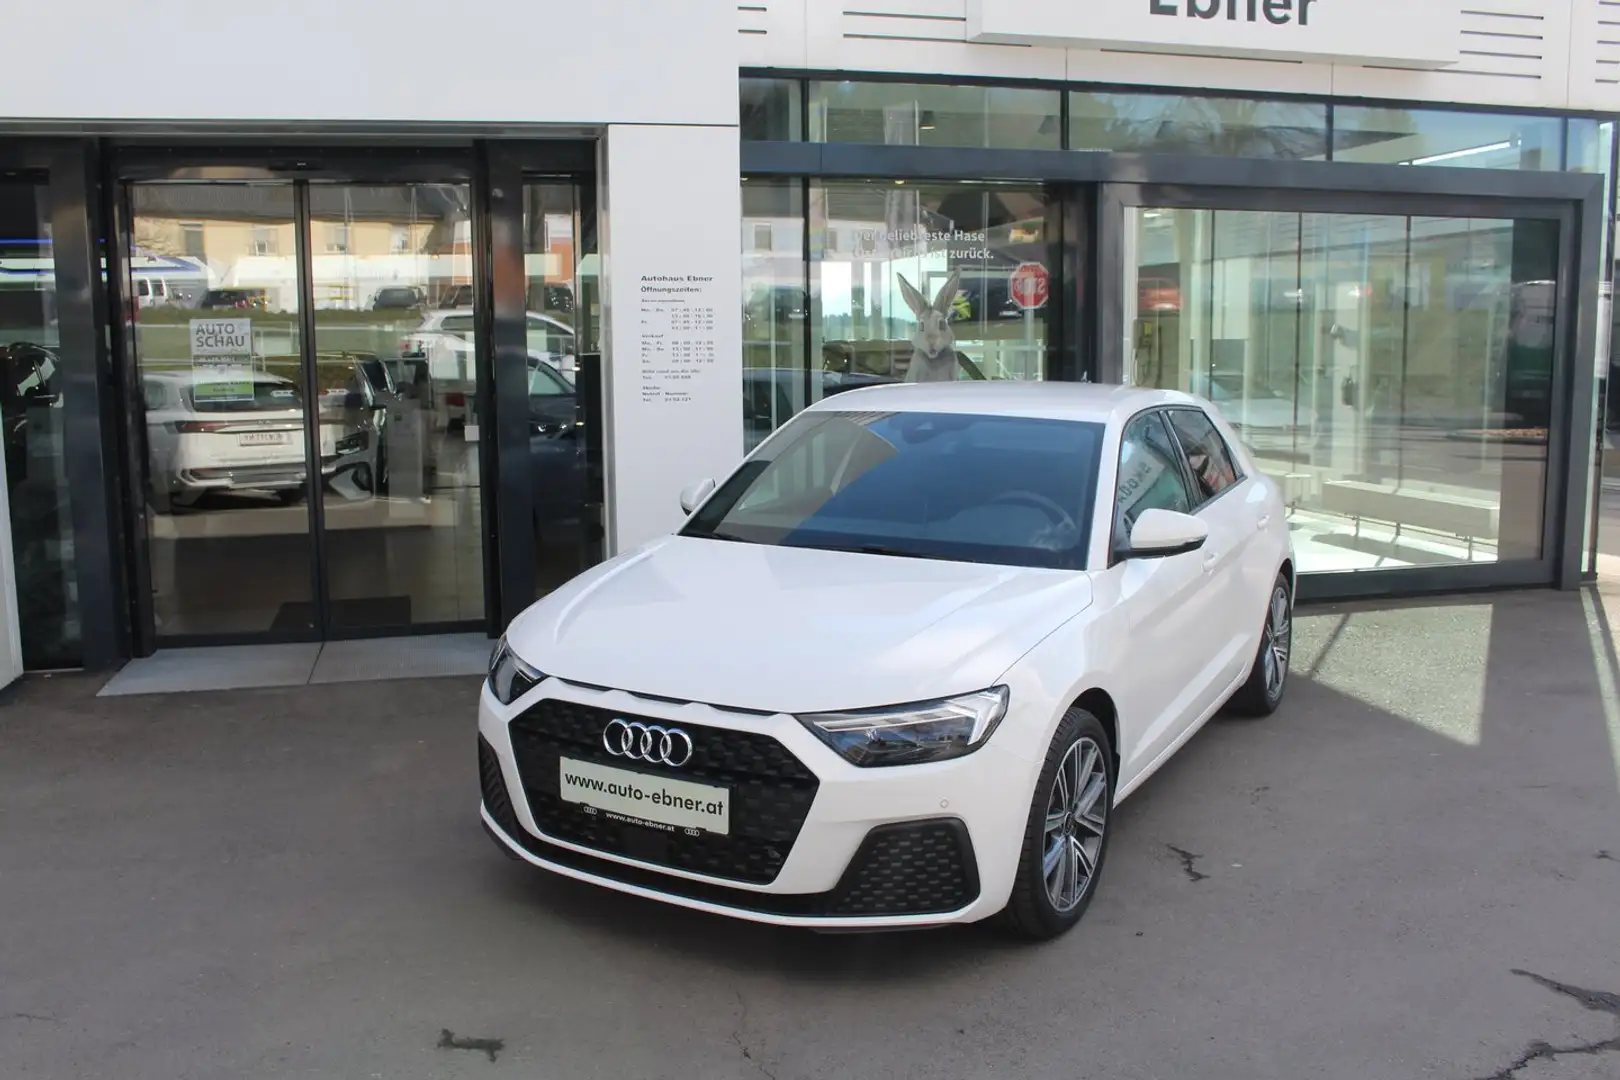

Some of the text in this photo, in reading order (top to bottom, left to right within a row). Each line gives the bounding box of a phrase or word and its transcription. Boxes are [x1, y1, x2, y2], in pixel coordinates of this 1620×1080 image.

[954, 229, 985, 242] Hase
[949, 247, 994, 260] zurück.
[641, 275, 714, 283] Autohaus Ebner
[196, 323, 235, 335] AUTO
[196, 335, 245, 348] SCHAU
[564, 771, 724, 816] www.auto-ebner.at
[605, 811, 676, 833] www.auto-ebner.at
